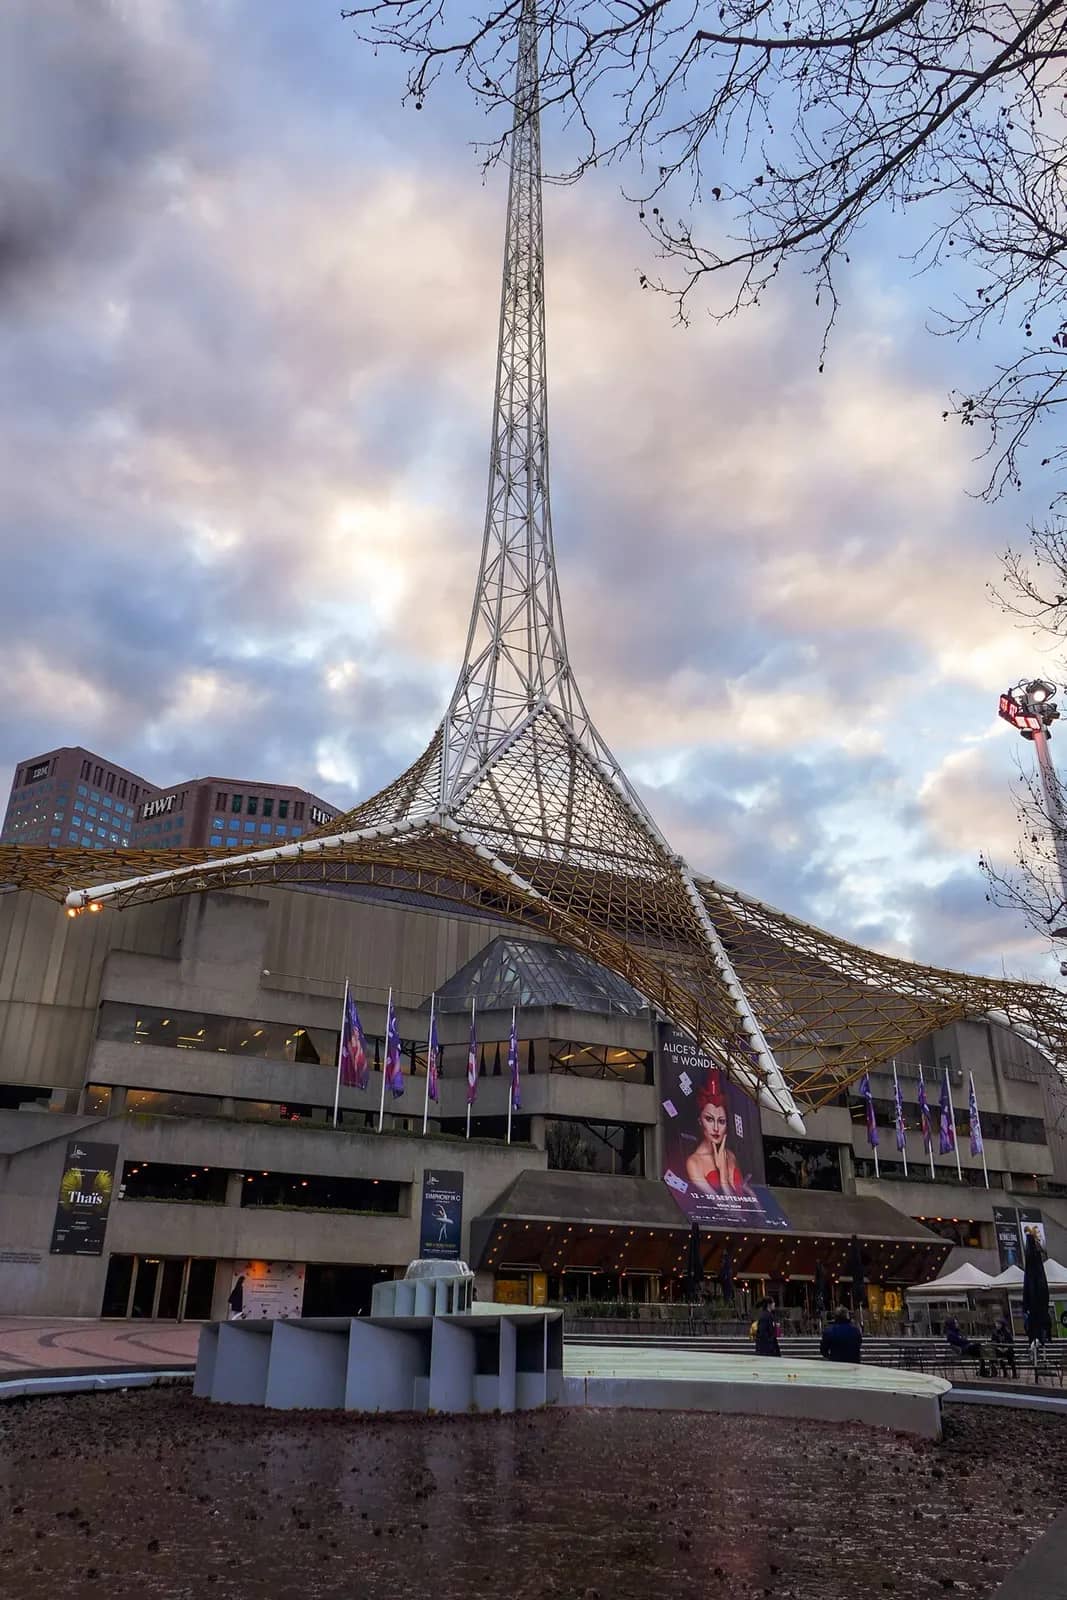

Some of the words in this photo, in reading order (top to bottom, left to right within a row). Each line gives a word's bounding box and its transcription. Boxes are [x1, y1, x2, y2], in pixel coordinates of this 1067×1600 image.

[143, 795, 176, 817] HWT
[663, 1042, 696, 1056] ALICE'S
[68, 1191, 103, 1204] Thaïs
[715, 1195, 758, 1203] SEPTEMBER
